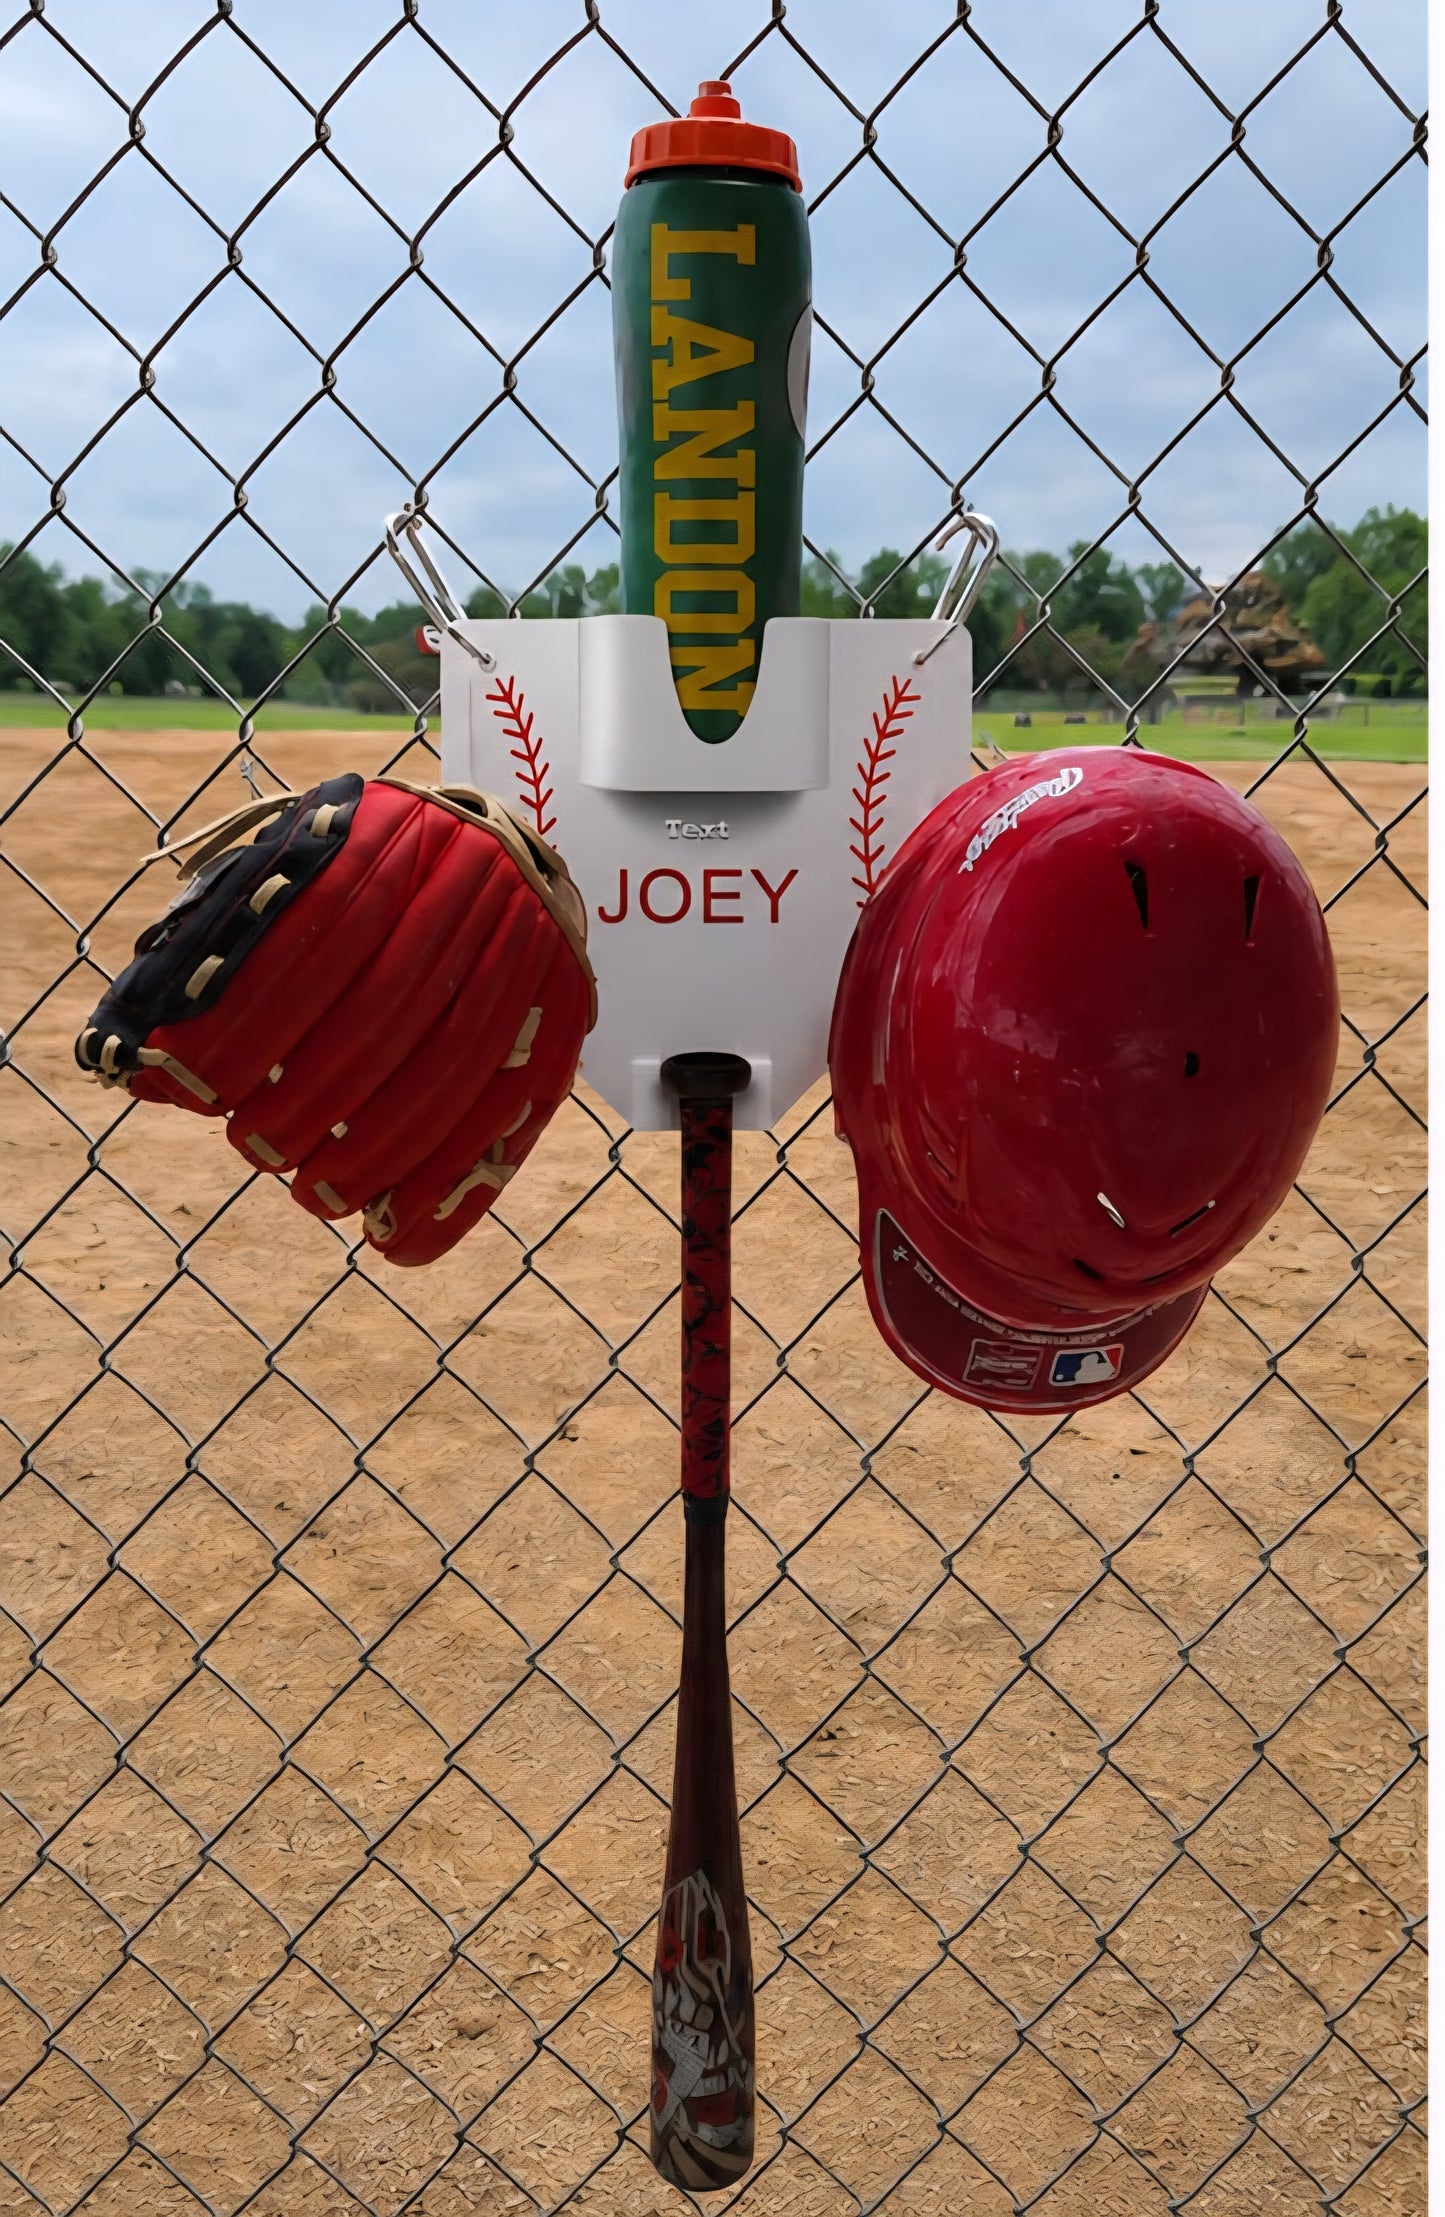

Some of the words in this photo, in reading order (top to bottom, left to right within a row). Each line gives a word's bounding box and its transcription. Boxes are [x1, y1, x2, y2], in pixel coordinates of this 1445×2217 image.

[650, 222, 757, 718] LANDON
[664, 819, 730, 840] Text
[597, 868, 799, 924] JOEY
